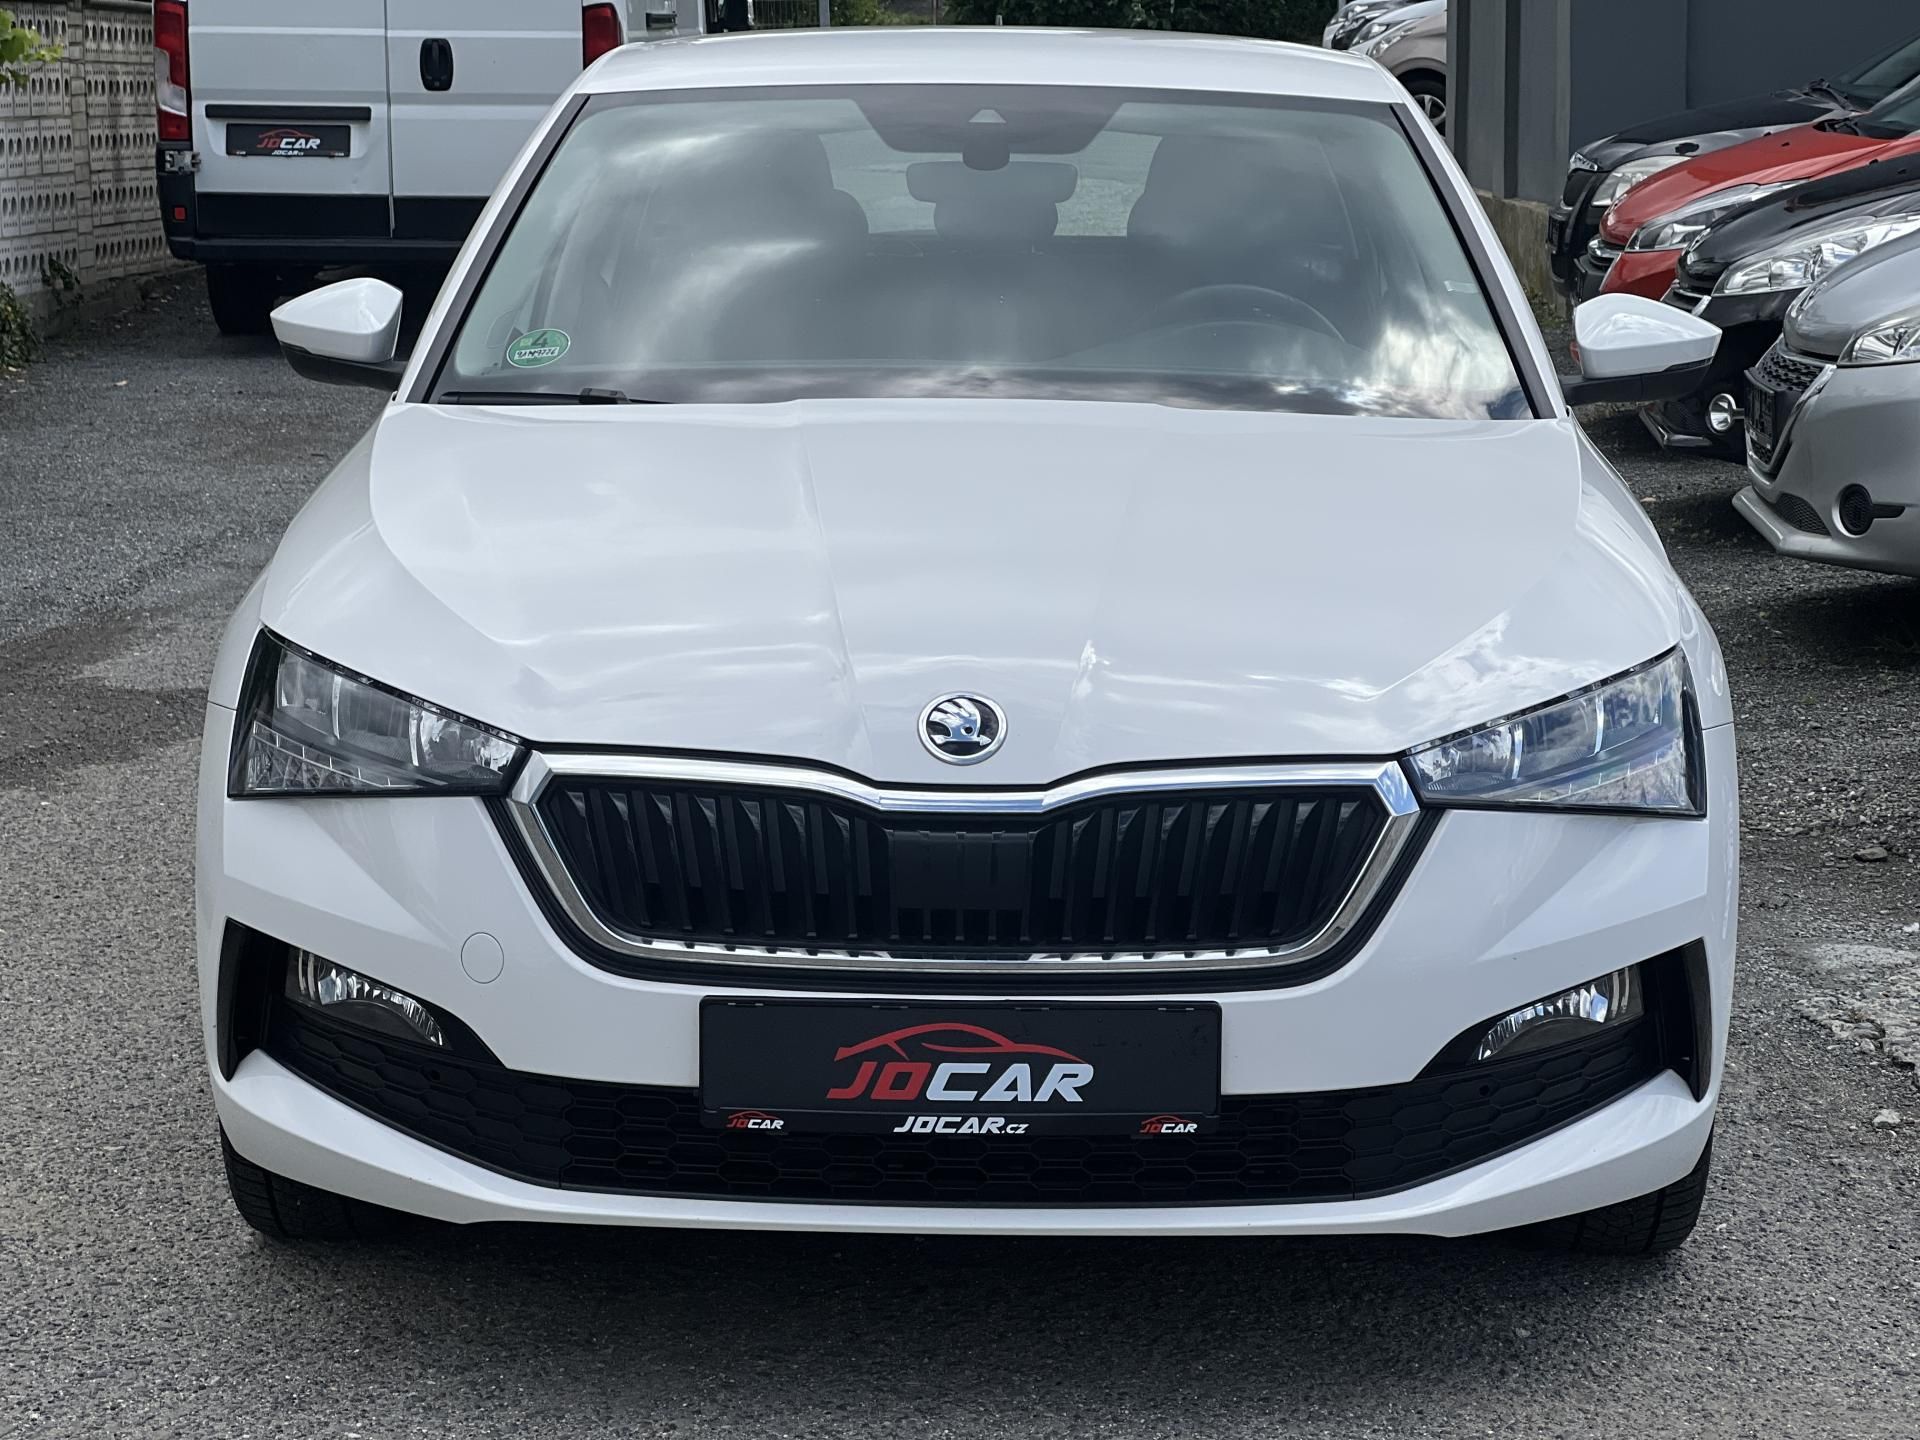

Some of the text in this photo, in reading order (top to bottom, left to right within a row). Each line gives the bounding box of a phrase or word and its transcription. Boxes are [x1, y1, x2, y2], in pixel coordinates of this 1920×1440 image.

[256, 138, 321, 149] JOCAR
[531, 331, 548, 347] 4
[826, 1061, 1094, 1102] JOCAR
[726, 1119, 784, 1129] JOCAR
[1139, 1123, 1197, 1133] JOCAR
